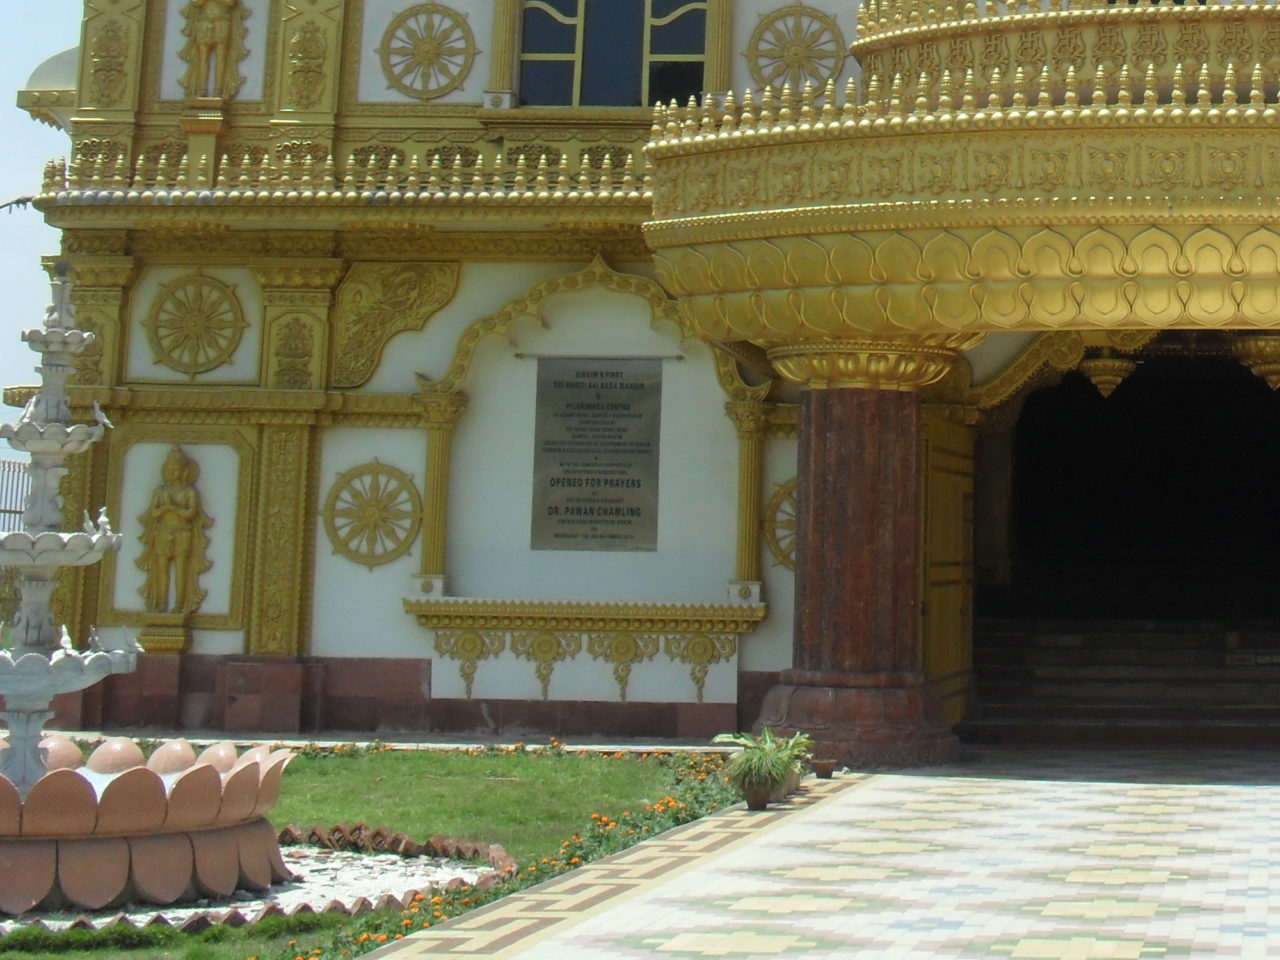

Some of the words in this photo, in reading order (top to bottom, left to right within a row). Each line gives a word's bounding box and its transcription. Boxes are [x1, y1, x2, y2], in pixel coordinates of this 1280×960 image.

[550, 478, 583, 488] OPENED
[585, 478, 601, 488] FOR
[603, 478, 641, 488] PRAYERS
[547, 506, 562, 517] DR.
[564, 506, 594, 517] PAWAN
[596, 506, 641, 517] CHAMLING
